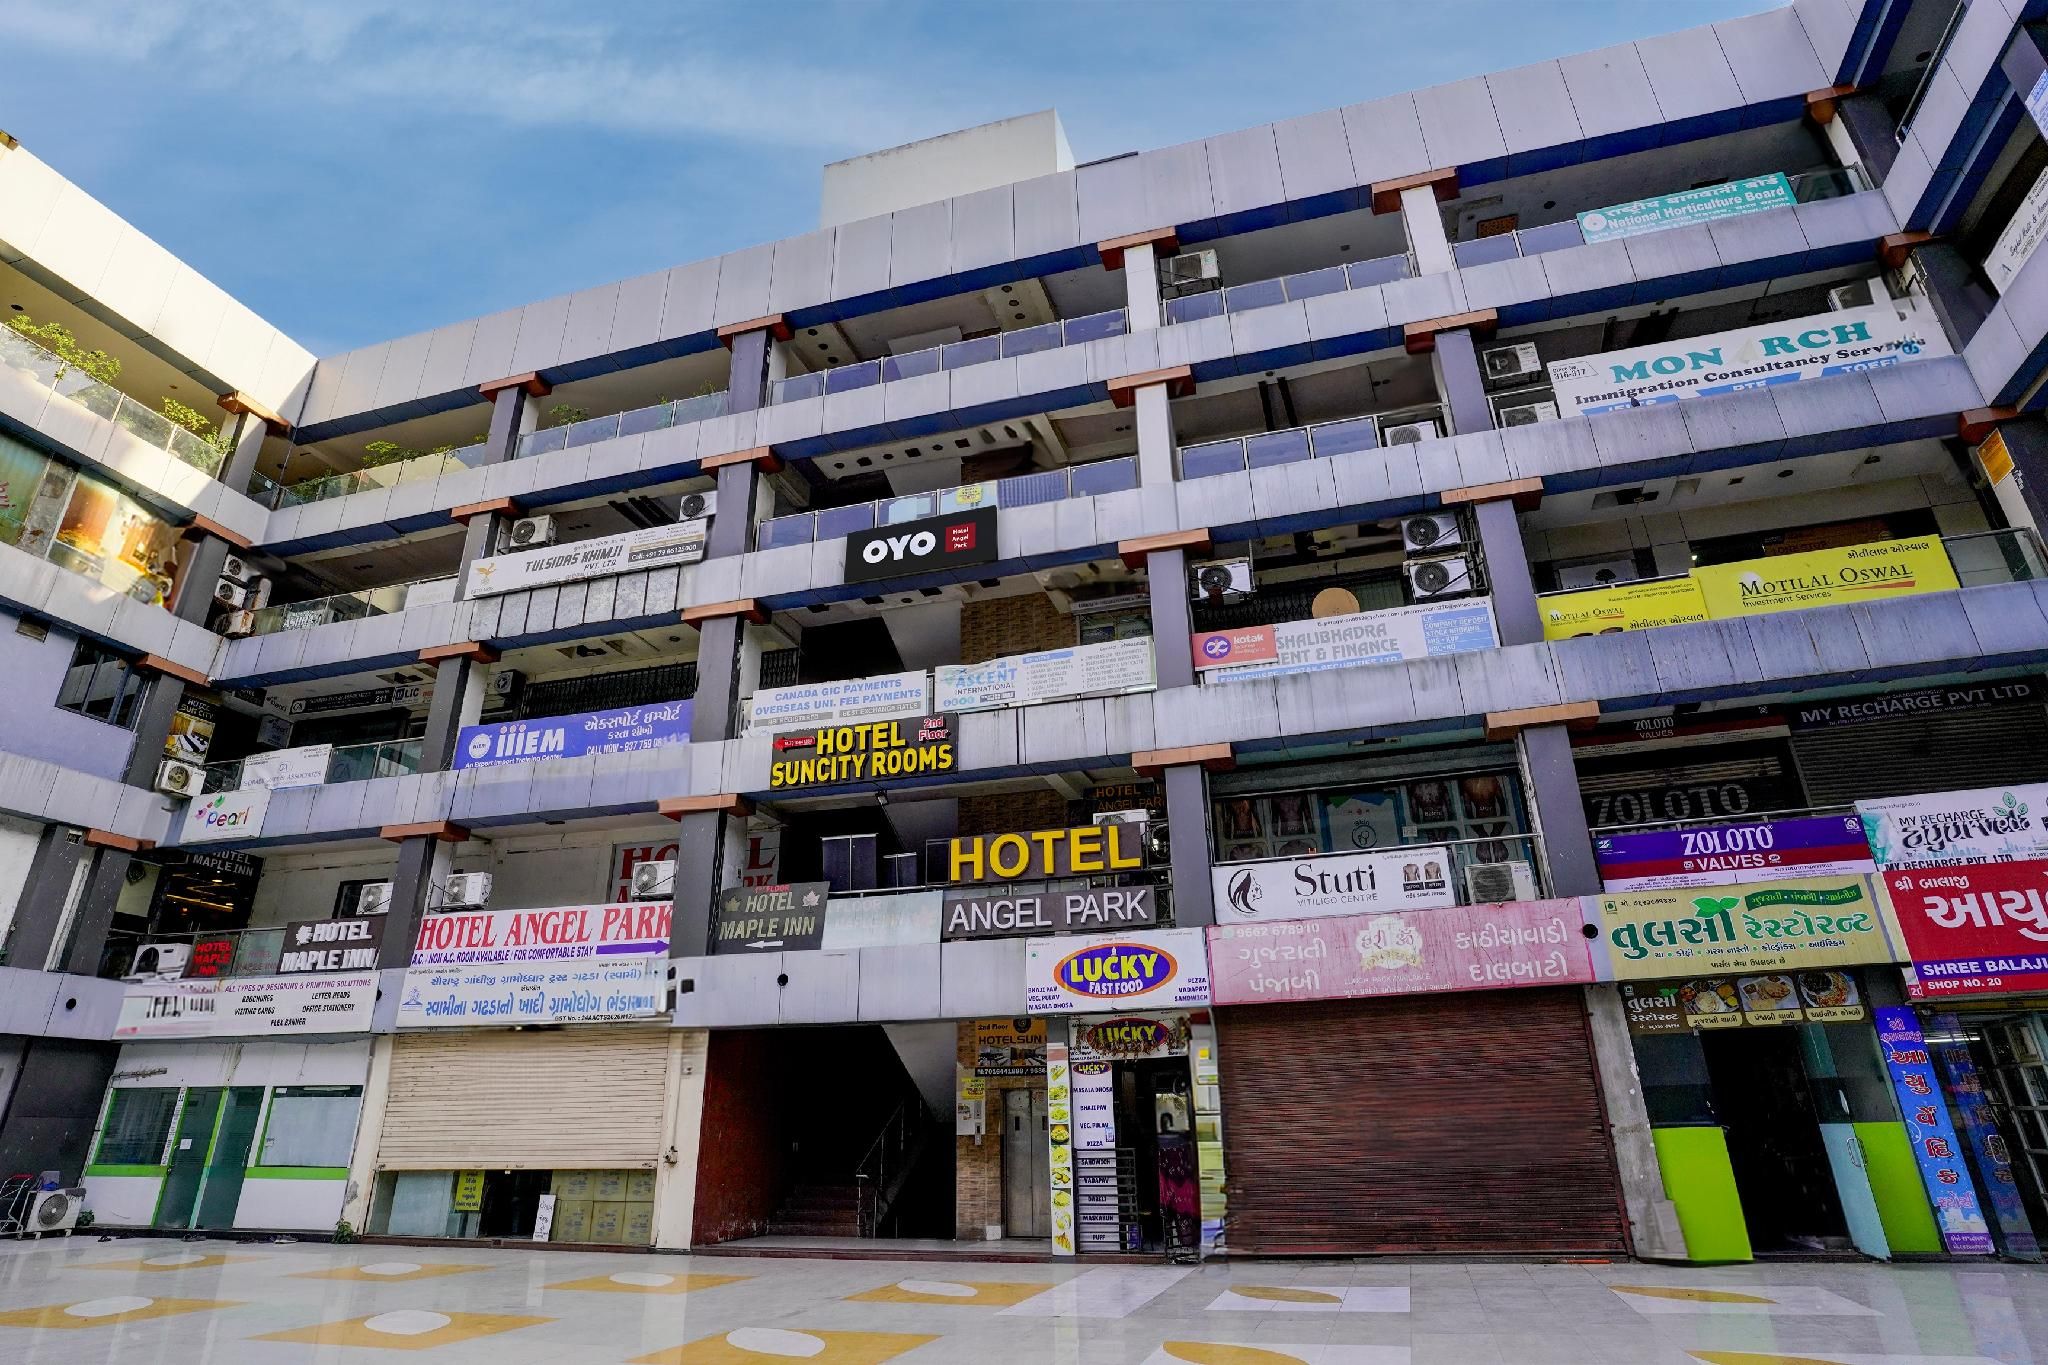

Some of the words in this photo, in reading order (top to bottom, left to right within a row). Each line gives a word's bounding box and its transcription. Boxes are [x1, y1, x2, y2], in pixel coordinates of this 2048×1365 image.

[1607, 210, 1662, 230] National
[1664, 196, 1743, 217] Horticulture
[1744, 186, 1786, 202] Board
[1574, 378, 1699, 405] Immigration
[1703, 355, 1830, 383] Consultancy
[952, 526, 969, 535] Hotel
[952, 534, 969, 543] Angel
[862, 531, 937, 564] OYO
[954, 541, 968, 549] Park
[525, 552, 579, 573] TULSIDAS
[581, 545, 624, 562] KHIMJI
[1743, 595, 1793, 608] Investment
[1796, 590, 1832, 602] Services
[1233, 633, 1265, 645] kotak
[1277, 622, 1388, 651] SHALIBHADRA
[1316, 649, 1328, 661] &
[1333, 638, 1400, 660] FINANCE
[955, 668, 1018, 688] ASCENT
[403, 688, 420, 699] LIC
[774, 689, 818, 701] CANADA
[821, 686, 840, 696] GIC
[843, 679, 902, 693] PAYMENTS
[955, 683, 1015, 696] INTERNATIONAL
[755, 702, 810, 716] OVERSEAS
[814, 699, 836, 710] UNI.
[839, 696, 860, 707] FEE
[862, 689, 922, 704] PAYMENTS
[1800, 707, 1831, 723] MY
[1838, 694, 1944, 718] RECHARGE
[1949, 689, 1985, 704] PVT
[1992, 684, 2031, 699] LTD
[923, 716, 944, 730] 2nd
[1634, 716, 1674, 731] ZOLOTO
[816, 721, 906, 755] HOTEL
[918, 728, 949, 741] Floor
[1640, 729, 1674, 739] VALVES
[586, 746, 602, 756] CALL
[602, 744, 619, 754] NOW
[465, 761, 474, 769] An
[475, 760, 494, 769] Export
[771, 752, 866, 787] SUNCITY
[871, 744, 954, 776] ROOMS
[1096, 784, 1140, 798] HOTEL
[1591, 783, 1749, 827] ZOLOTO
[206, 806, 250, 829] pearl
[1899, 816, 1916, 827] MY
[1920, 808, 1986, 824] RECHARGE
[1681, 825, 1774, 856] ZOLOTO
[950, 826, 1142, 881] HOTEL
[1696, 853, 1766, 871] VALVES
[766, 884, 790, 893] FLOOR
[1294, 863, 1377, 897] Stuti
[745, 892, 796, 913] HOTEL
[1297, 897, 1338, 907] VITILIGO
[1341, 893, 1379, 905] CENTRE
[949, 897, 1053, 932] ANGEL
[1065, 889, 1149, 925] PARK
[312, 921, 373, 942] HOTEL
[416, 914, 498, 951] HOTEL
[503, 909, 593, 947] ANGEL
[599, 904, 674, 942] PARK
[719, 917, 779, 940] MAPLE
[783, 916, 816, 937] INN
[1236, 925, 1269, 938] 9662
[196, 940, 232, 952] HOTEL
[429, 952, 442, 964] NON
[456, 951, 475, 963] ROOM
[475, 949, 509, 962] AVAILABLE
[513, 948, 527, 961] FOR
[527, 947, 576, 960] COMFORTABLE
[576, 945, 594, 957] STAY
[192, 952, 232, 965] MAPLE
[279, 949, 339, 973] MAPLE
[342, 948, 376, 969] INN
[1469, 951, 1568, 984] દાલબાટી
[199, 965, 218, 976] INN
[1070, 953, 1158, 984] LUCKY
[1923, 961, 1982, 976] SHREE
[225, 985, 236, 993] ALL
[237, 984, 255, 992] TYPES
[256, 983, 265, 991] OF
[304, 980, 337, 989] PRINTING
[337, 978, 372, 987] SOLUTIONS
[1088, 982, 1112, 995] FAST
[1114, 979, 1143, 993] FOOD
[1927, 980, 1960, 990] SHOP
[1963, 978, 1985, 988] NO.
[1987, 977, 2002, 987] 20
[311, 992, 331, 1000] LETTER
[1174, 993, 1208, 1002] SANDWICH
[1028, 1003, 1053, 1011] MASALA
[1098, 1024, 1156, 1042] LUCKY
[1078, 1063, 1106, 1072] LUCKY
